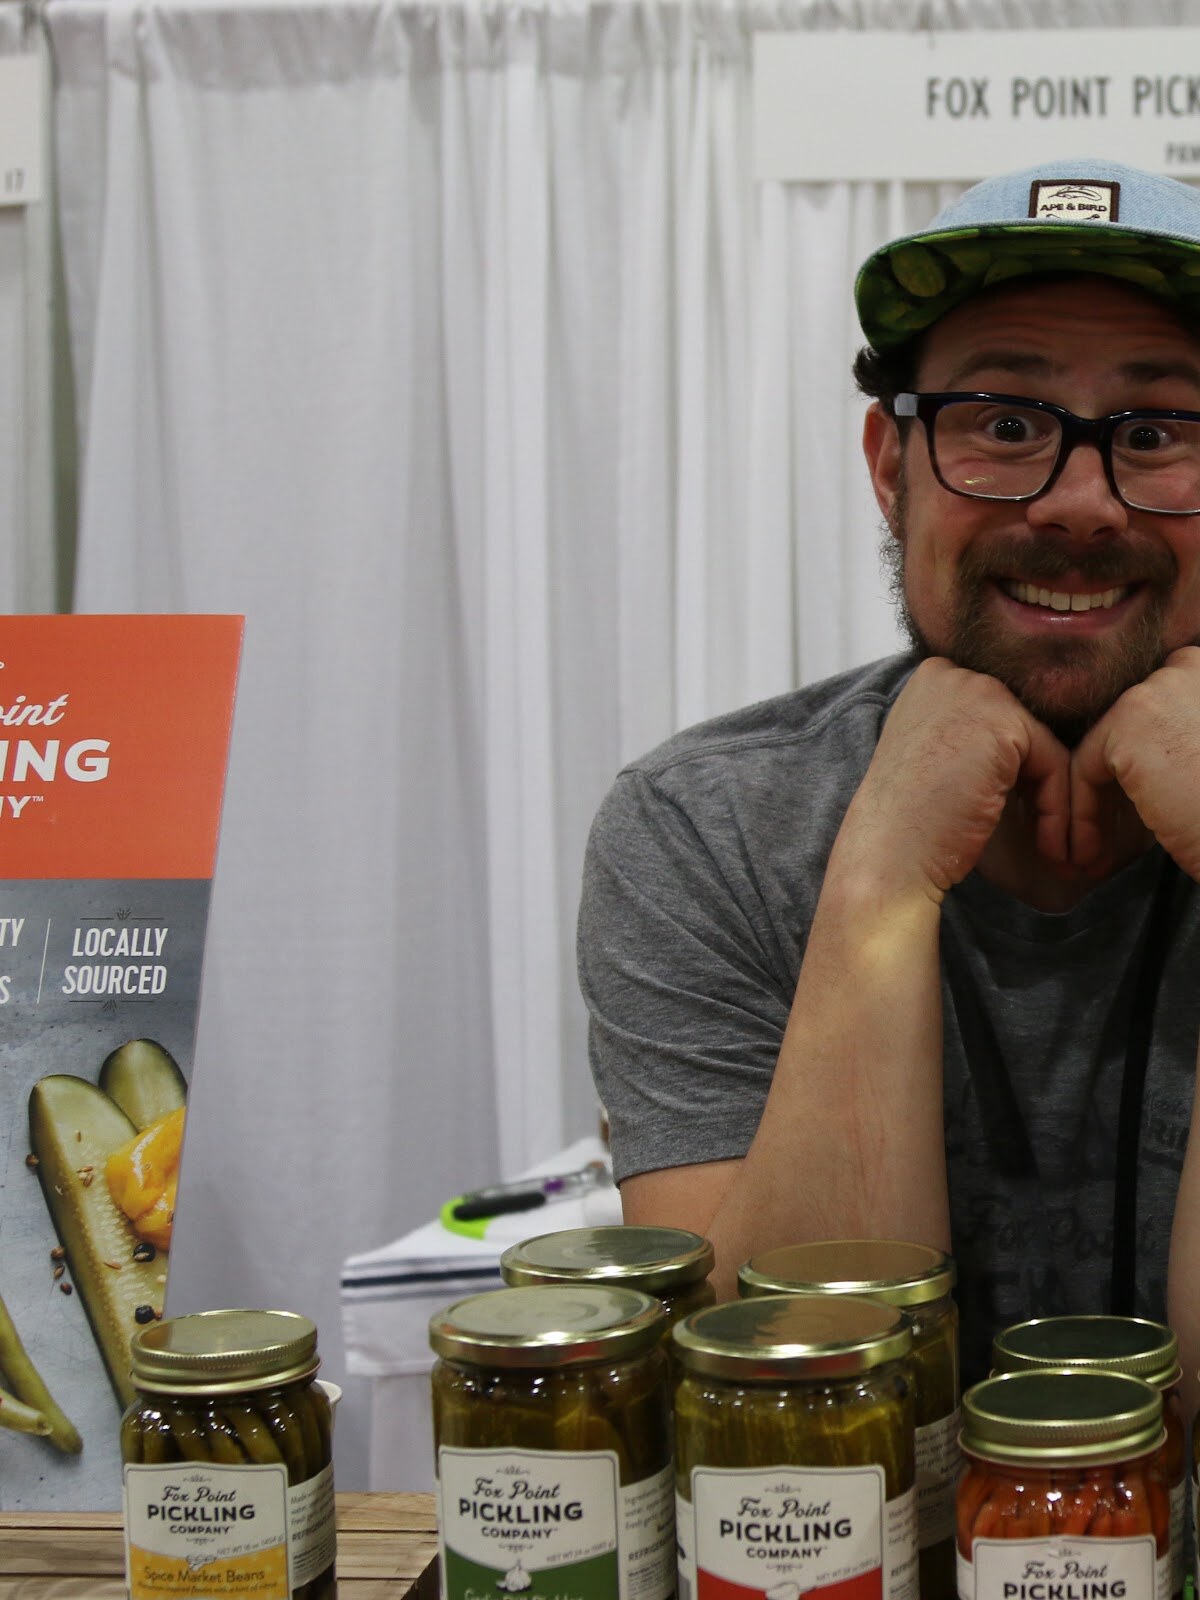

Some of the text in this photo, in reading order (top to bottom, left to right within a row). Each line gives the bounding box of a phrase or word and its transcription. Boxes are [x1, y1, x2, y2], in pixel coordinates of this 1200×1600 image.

[926, 76, 990, 119] FOX
[1010, 75, 1110, 118] POINT
[1040, 202, 1108, 212] APE & BIRD
[72, 927, 168, 958] LOCALLY
[61, 964, 167, 995] SOURCED
[162, 1486, 237, 1502] Fox Point
[473, 1478, 560, 1500] Fox Point
[147, 1504, 255, 1522] PICKLING
[459, 1497, 583, 1524] PICKLING
[737, 1497, 831, 1518] Fox Point
[169, 1525, 230, 1535] COMPANY
[481, 1526, 553, 1539] COMPANY
[720, 1518, 852, 1543] PICKLING
[746, 1547, 822, 1559] COMPANY
[144, 1566, 265, 1585] Spice Market Beans
[1022, 1561, 1107, 1580] Fox Point
[1003, 1580, 1127, 1600] PICKLING
